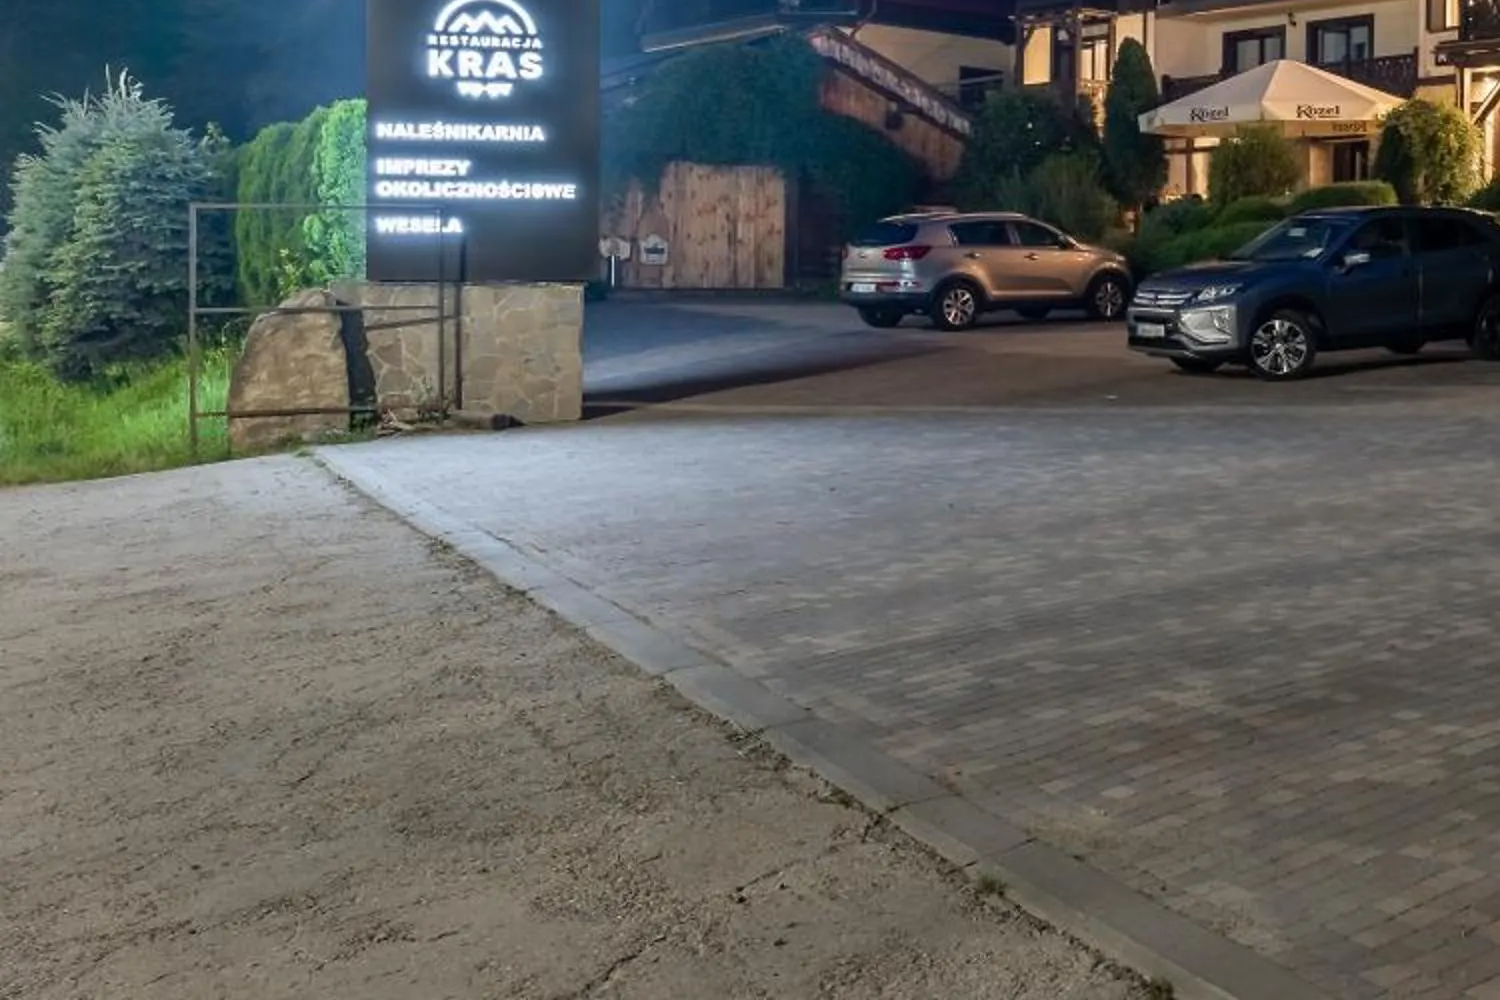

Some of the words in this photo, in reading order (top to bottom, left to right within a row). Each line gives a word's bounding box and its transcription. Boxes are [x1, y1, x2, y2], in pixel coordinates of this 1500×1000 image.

[427, 34, 543, 49] RESTAURACJA
[427, 49, 544, 80] KRAS
[375, 121, 545, 142] NALEŚNIKARNIA
[375, 157, 471, 177] IMPREZY
[375, 178, 577, 200] OKOLICZNOŚCIOWE
